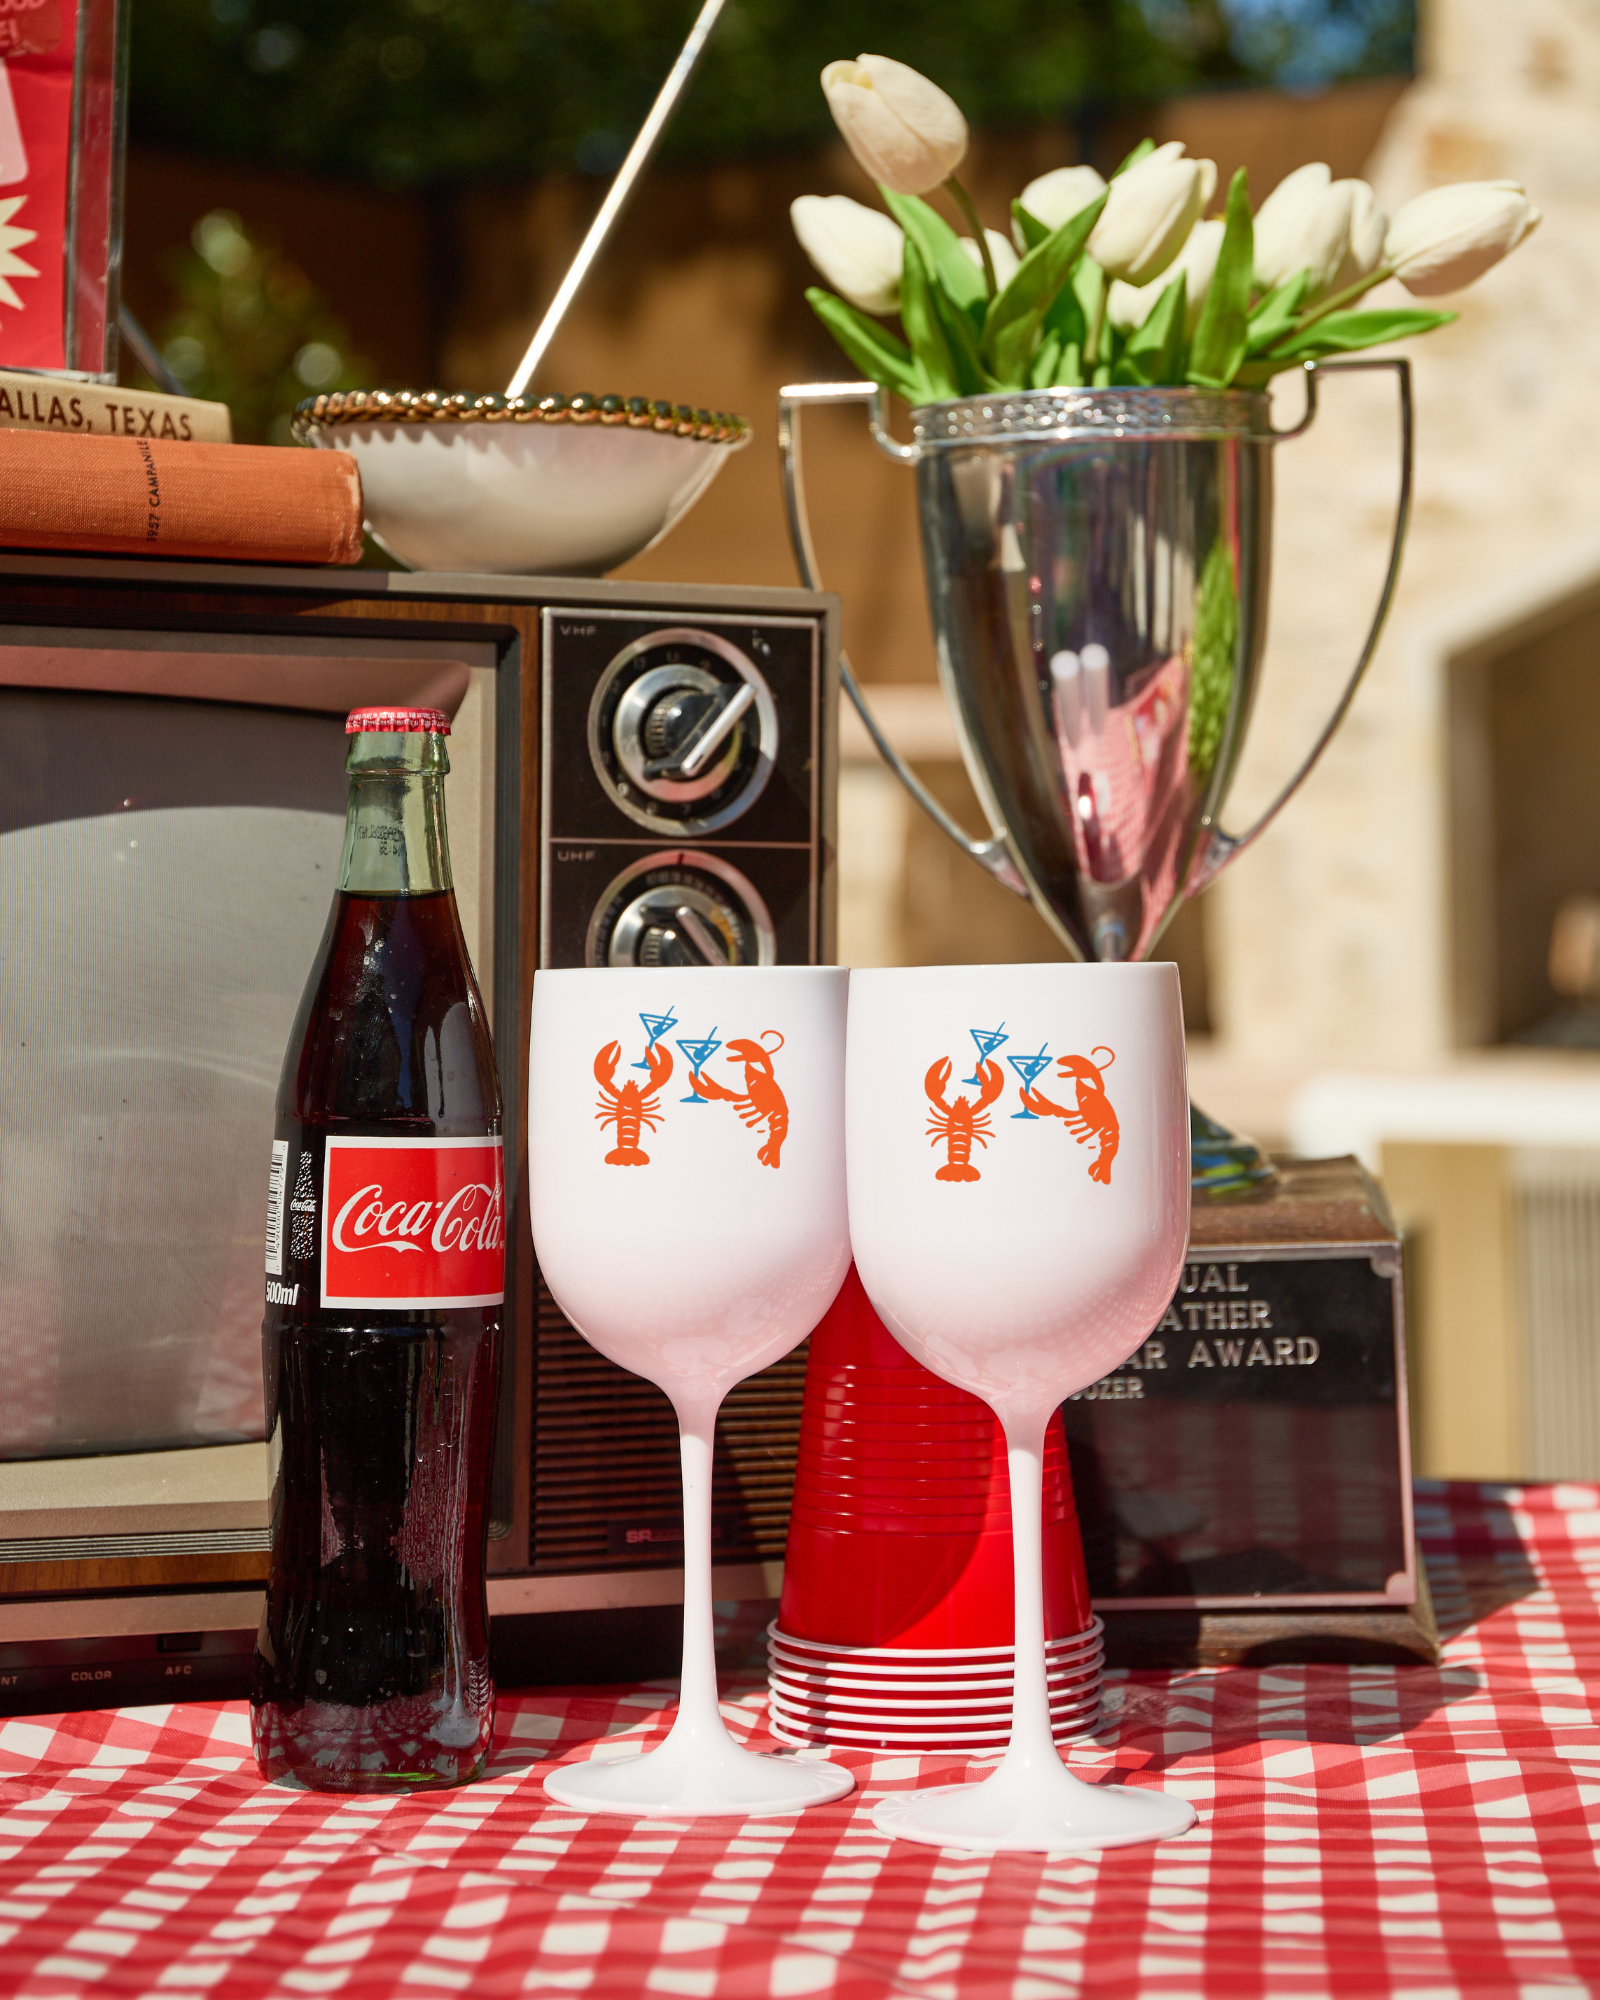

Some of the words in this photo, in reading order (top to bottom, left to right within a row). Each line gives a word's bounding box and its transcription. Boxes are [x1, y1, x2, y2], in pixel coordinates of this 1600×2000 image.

[0, 387, 92, 431] ALLAS,
[105, 403, 192, 441] TEXAS
[136, 440, 161, 507] CAMPANILE
[147, 513, 160, 542] 1957
[560, 624, 597, 636] VHF
[332, 1184, 502, 1253] Coca-Cola
[265, 1280, 300, 1306] 500ml
[1180, 1264, 1249, 1293] UAL
[1156, 1301, 1274, 1332] ATHER
[1187, 1336, 1320, 1368] AWARD
[71, 1670, 112, 1682] COLOR
[165, 1665, 192, 1676] AFC
